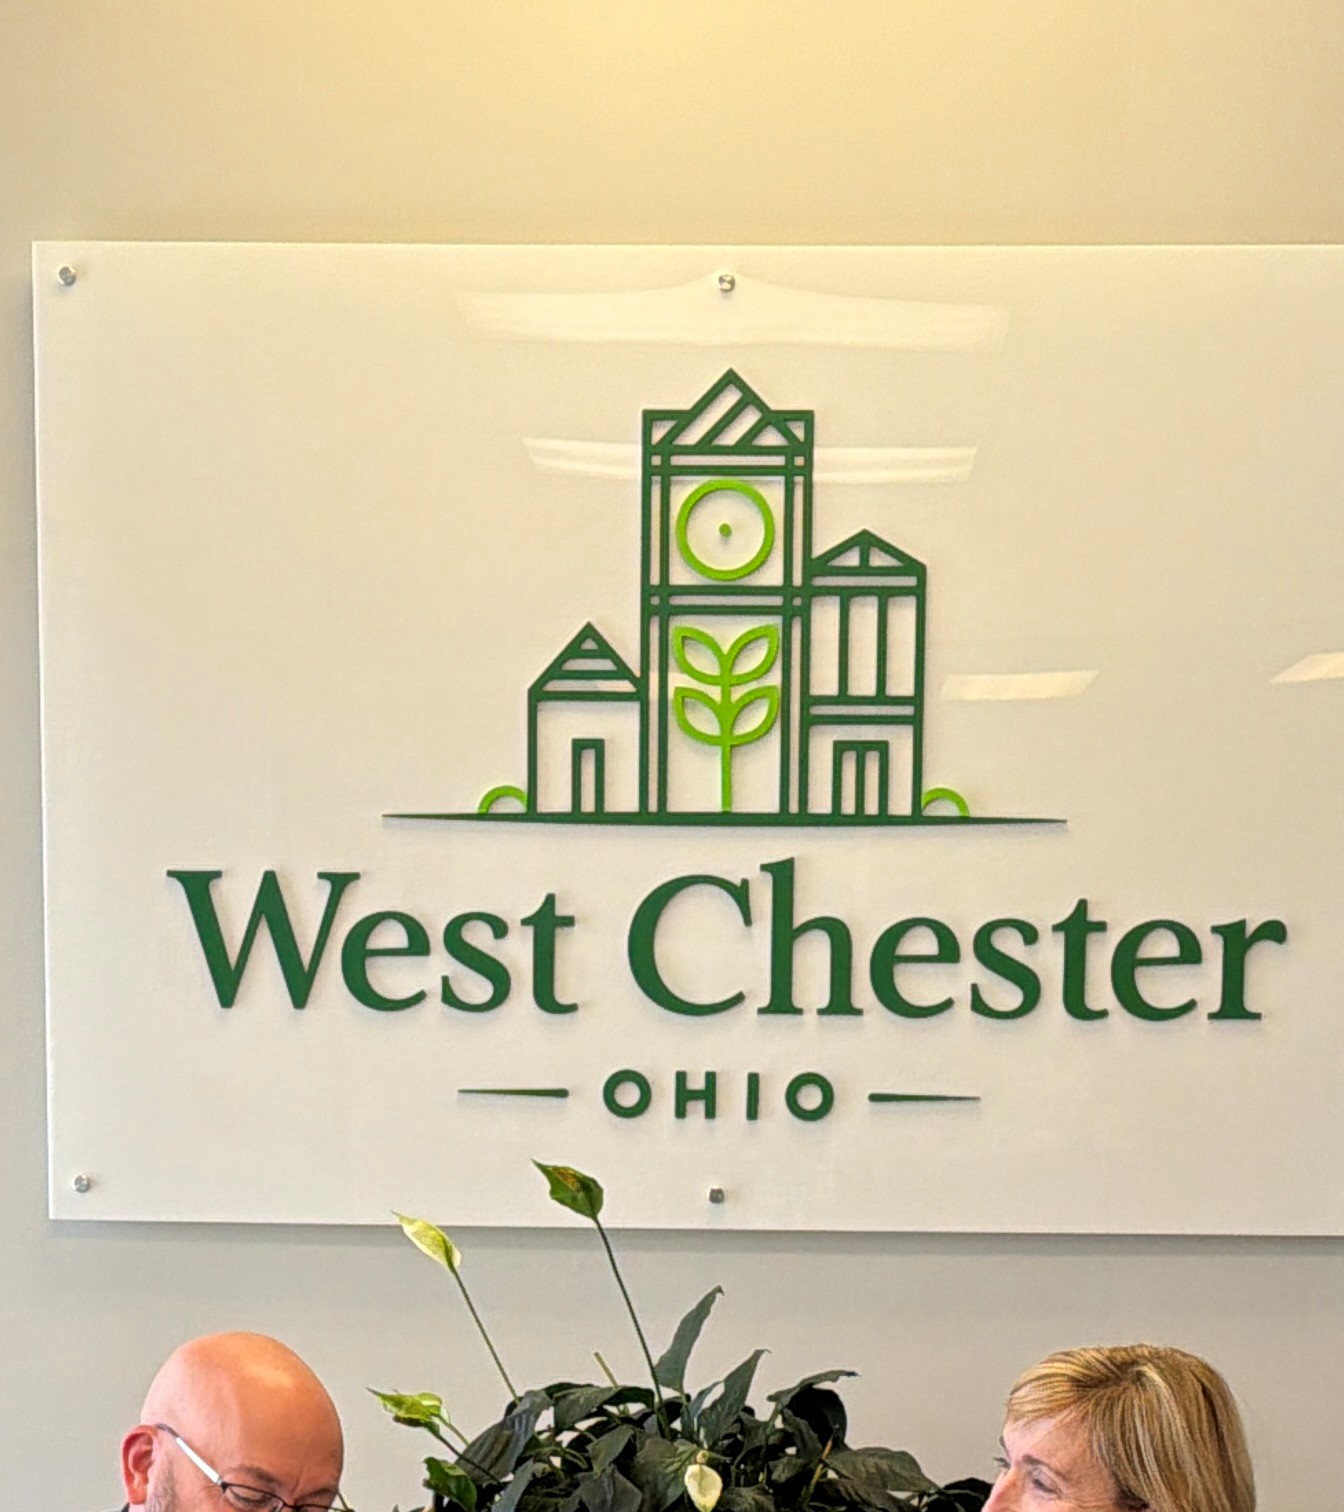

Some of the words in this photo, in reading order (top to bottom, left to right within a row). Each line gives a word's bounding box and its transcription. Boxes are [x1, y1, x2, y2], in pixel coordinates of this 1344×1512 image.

[166, 868, 579, 1015] West
[627, 856, 1288, 1022] Chester
[602, 1068, 835, 1122] OHIO
